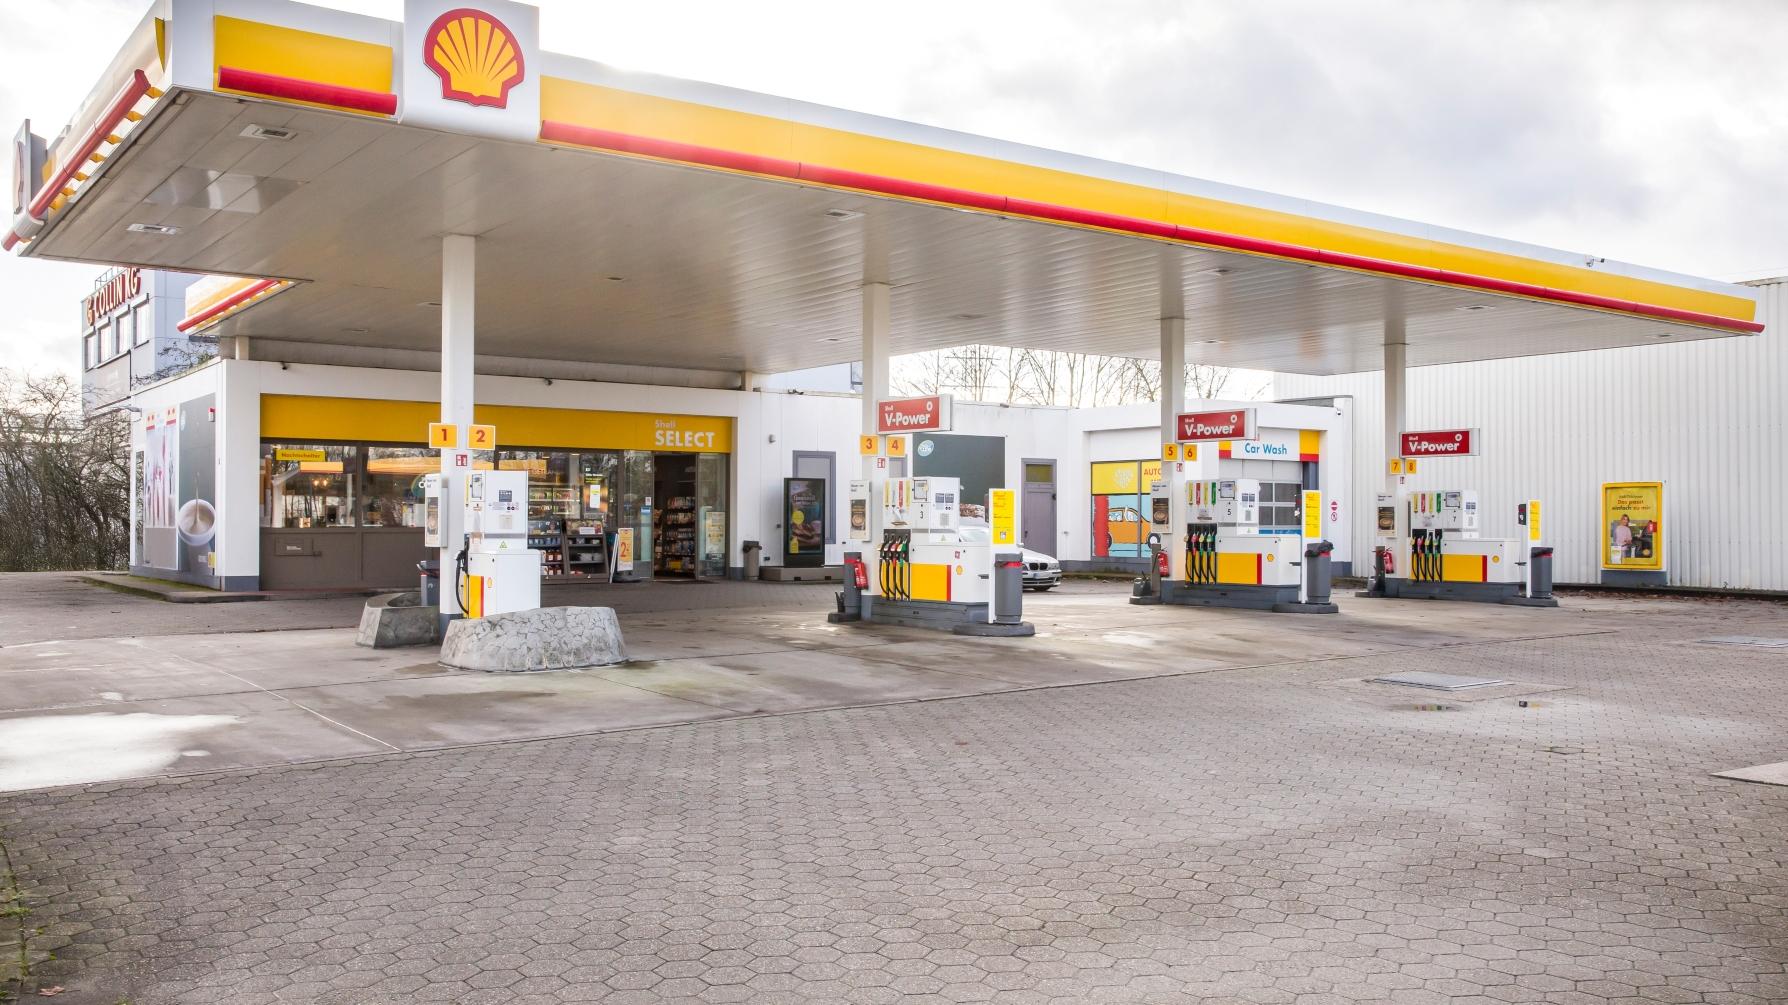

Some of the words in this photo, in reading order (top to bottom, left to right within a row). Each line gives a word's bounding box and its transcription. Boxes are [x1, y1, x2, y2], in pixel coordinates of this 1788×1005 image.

[94, 273, 126, 318] COLLIN
[655, 419, 676, 428] Shell
[884, 412, 931, 426] V-Power
[441, 428, 448, 441] 1
[1184, 423, 1235, 436] V-Power
[475, 429, 486, 443] 2
[655, 430, 715, 448] SELECT
[865, 438, 873, 450] 3
[891, 439, 899, 450] 4
[1244, 442, 1260, 454] Car
[1262, 443, 1288, 455] Wash
[1408, 441, 1460, 452] V-Power
[1167, 447, 1173, 456] 5
[1187, 448, 1193, 458] 6
[1393, 462, 1398, 471] 7
[1409, 462, 1414, 471] 8
[919, 511, 924, 519] 3
[1227, 508, 1232, 516] 5
